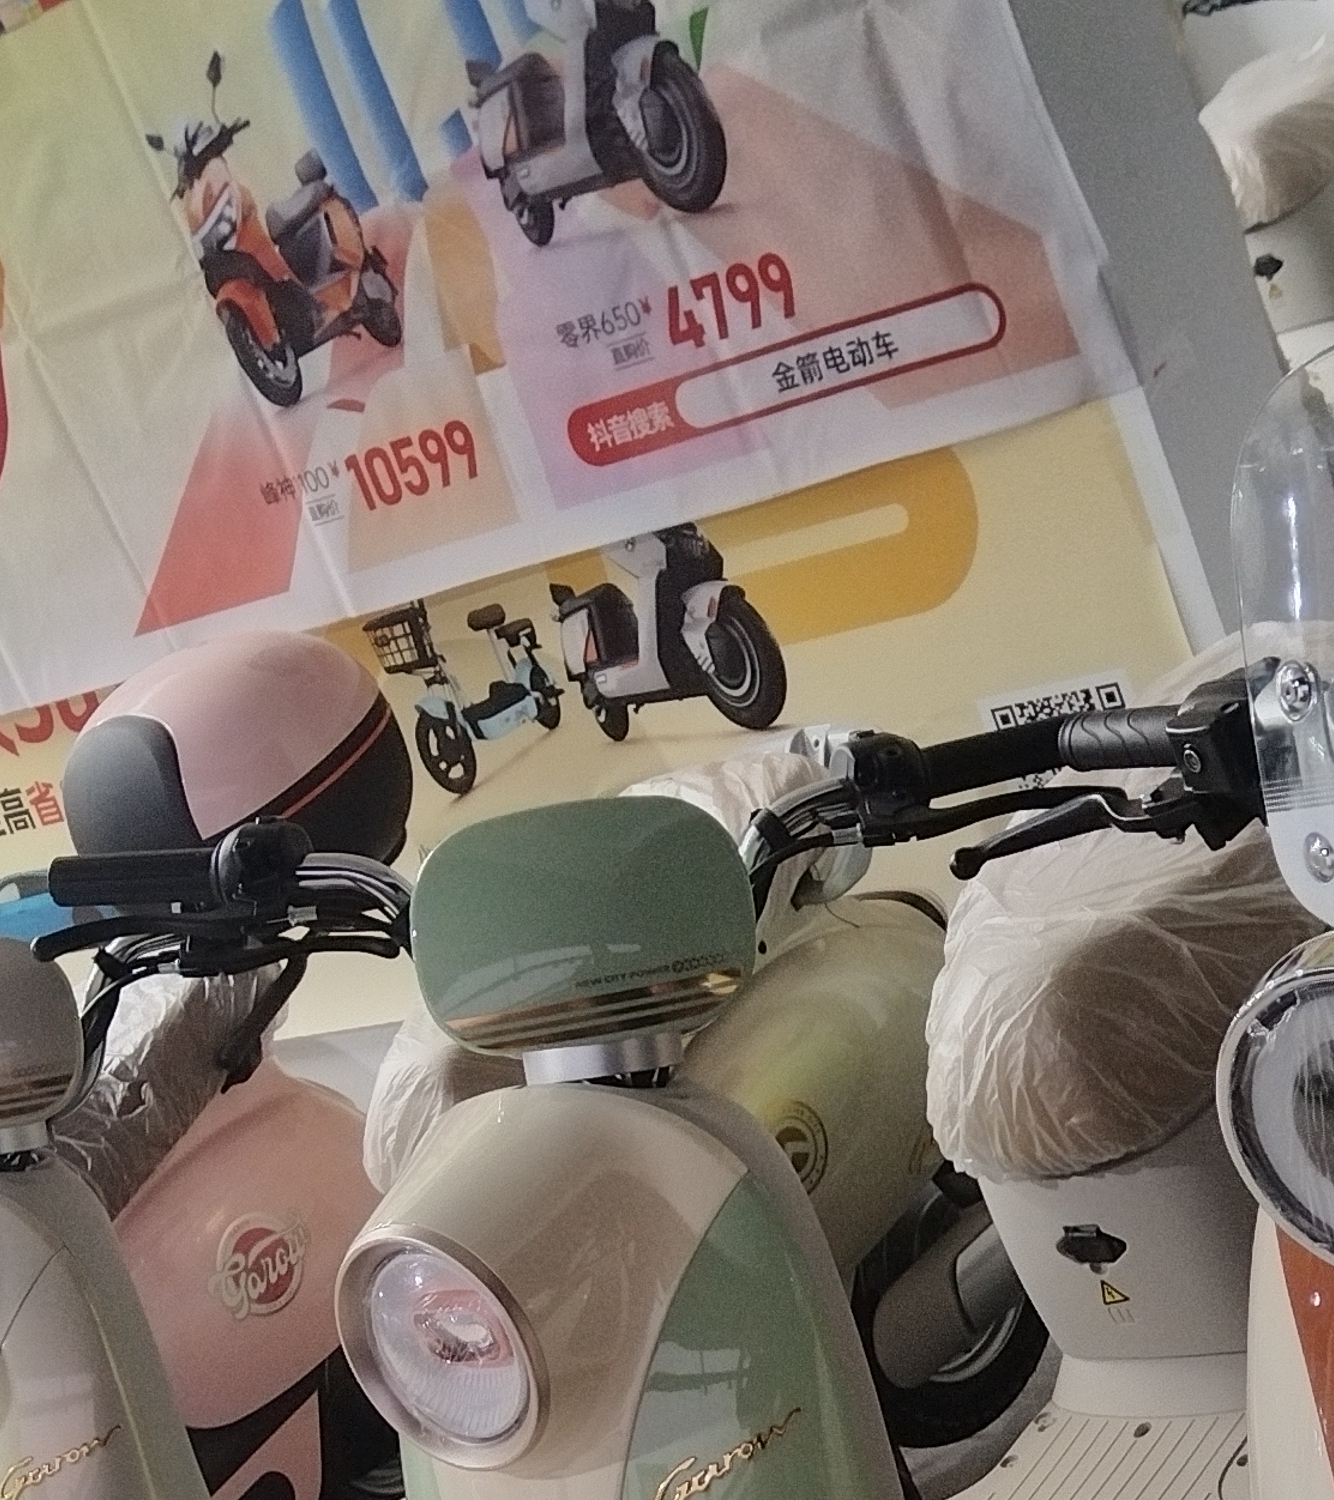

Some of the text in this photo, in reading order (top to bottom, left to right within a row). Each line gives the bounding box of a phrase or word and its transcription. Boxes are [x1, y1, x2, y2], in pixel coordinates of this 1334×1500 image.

[668, 252, 795, 348] 4799
[772, 331, 899, 393] 金箭电动车
[587, 401, 675, 451] 抖音搜索
[344, 420, 478, 511] 10599
